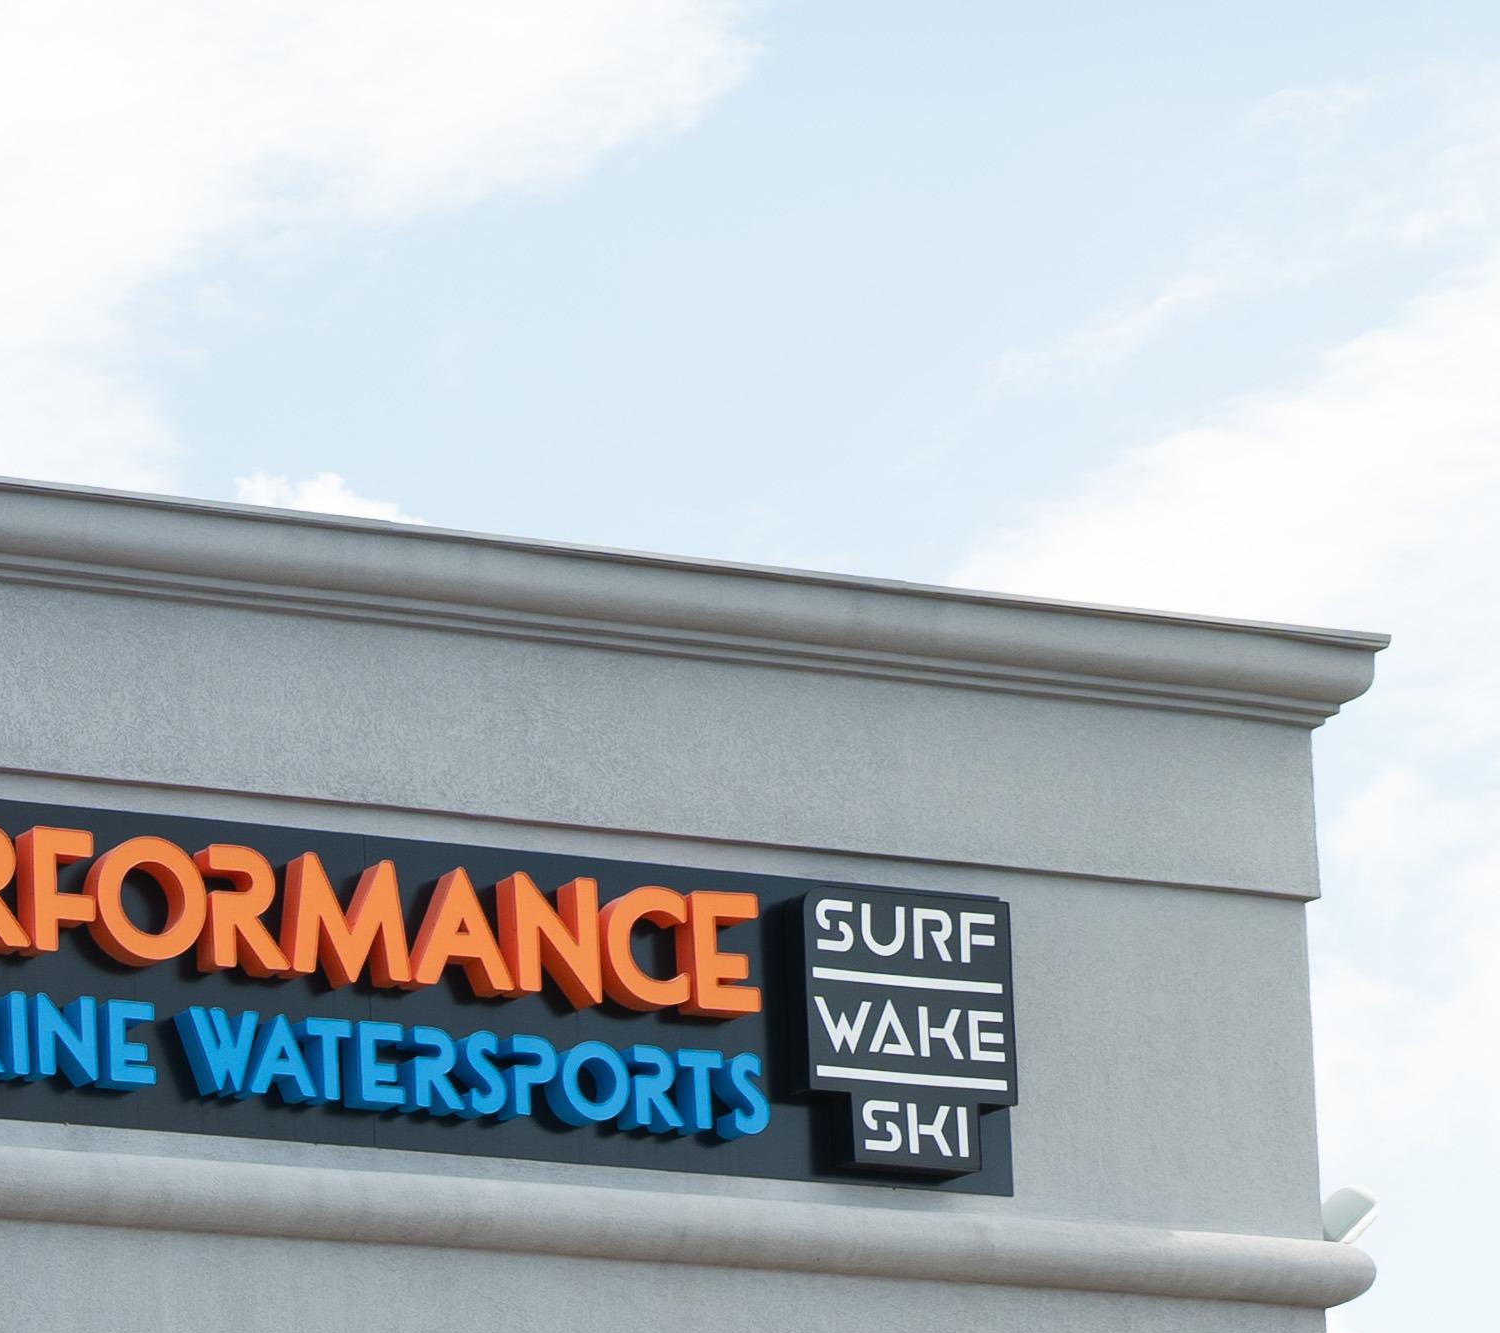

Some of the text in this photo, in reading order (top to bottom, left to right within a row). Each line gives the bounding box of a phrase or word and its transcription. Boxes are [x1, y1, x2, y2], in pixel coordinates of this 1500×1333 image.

[815, 898, 996, 964] SURF
[814, 995, 1006, 1063] WAKE
[174, 1005, 771, 1138] WATERSPORTS
[862, 1099, 970, 1158] SKI
